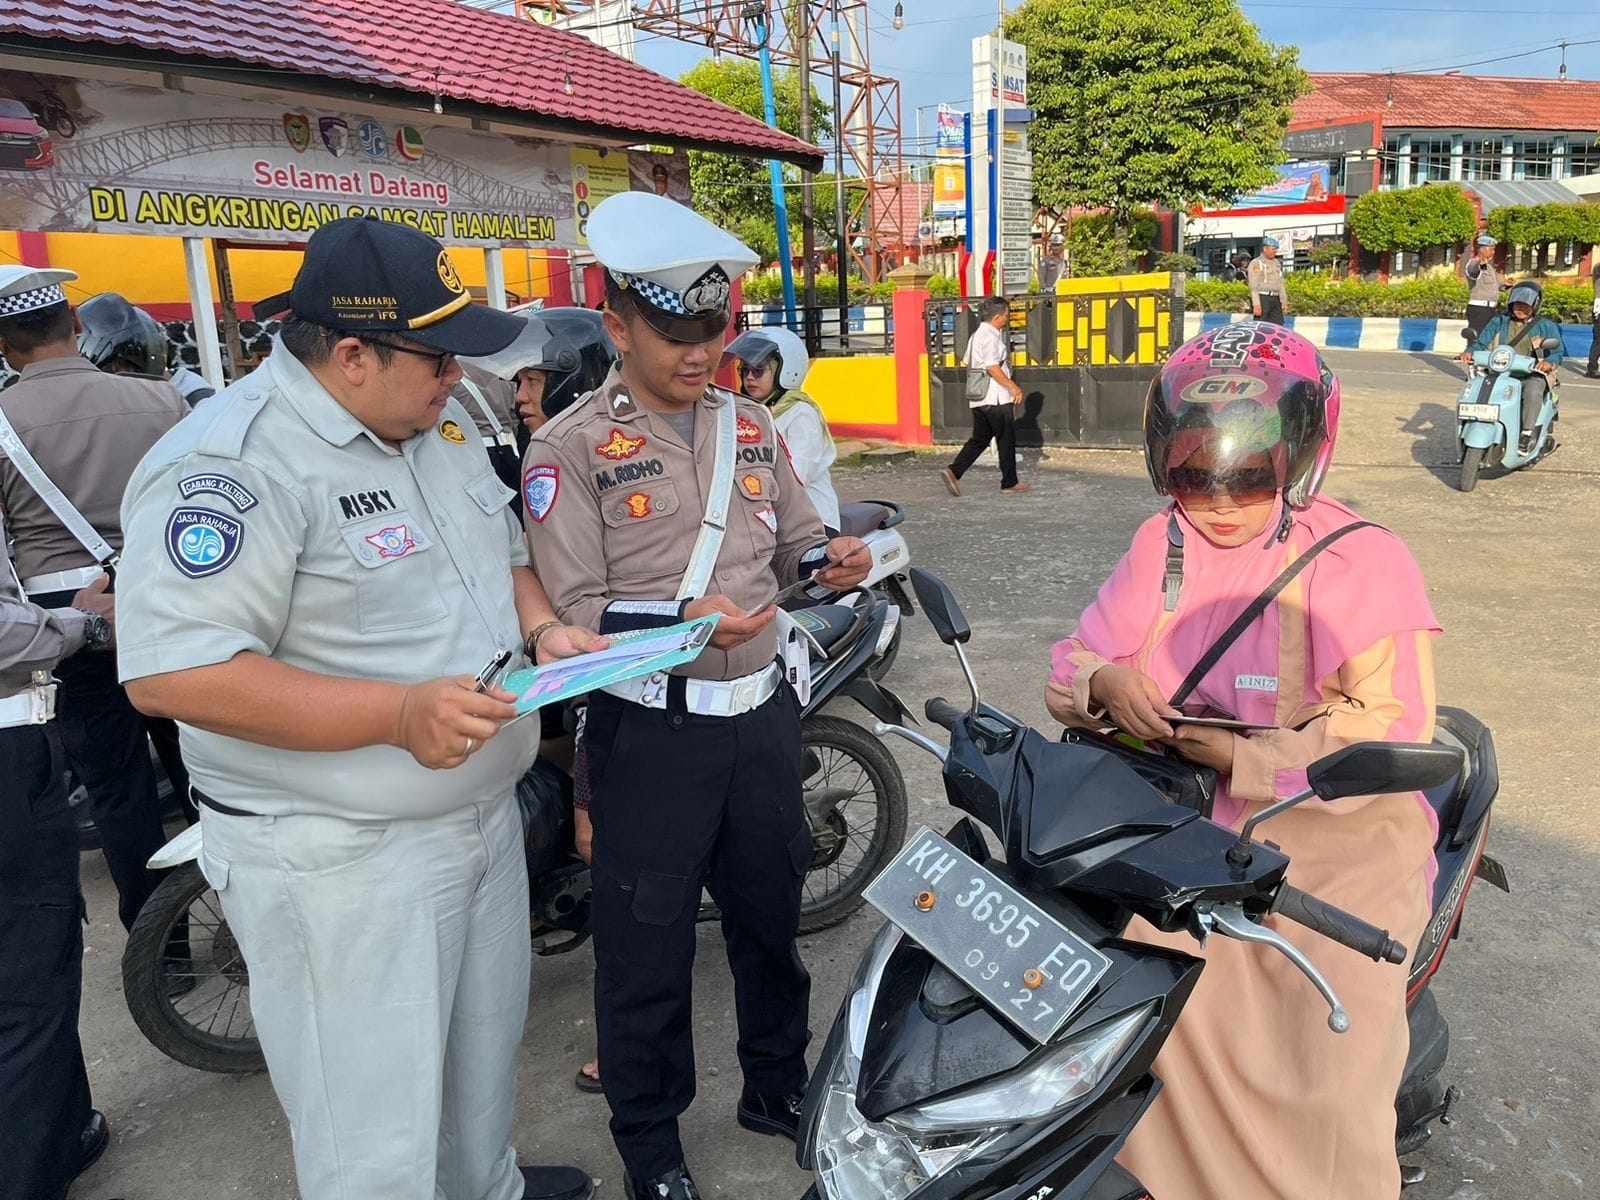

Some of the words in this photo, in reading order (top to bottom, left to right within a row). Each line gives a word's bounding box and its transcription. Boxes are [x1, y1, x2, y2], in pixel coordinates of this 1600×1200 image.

[992, 72, 1025, 94] SMSAT
[254, 161, 361, 193] Selamat
[368, 171, 448, 205] Datang
[89, 187, 128, 222] DI
[136, 190, 340, 233] ANGKRINGAN
[452, 211, 556, 241] HAMALEM
[332, 296, 353, 306] JASA
[354, 296, 398, 307] RAHARJA
[379, 311, 398, 320] IFG
[1198, 380, 1250, 395] GM
[185, 479, 217, 491] CABANG
[218, 480, 249, 506] KALTENG
[338, 489, 397, 520] RISKY
[176, 513, 198, 524] JASA
[200, 515, 237, 538] RAHARJA
[906, 839, 957, 887] KH
[955, 877, 1040, 949] 3695
